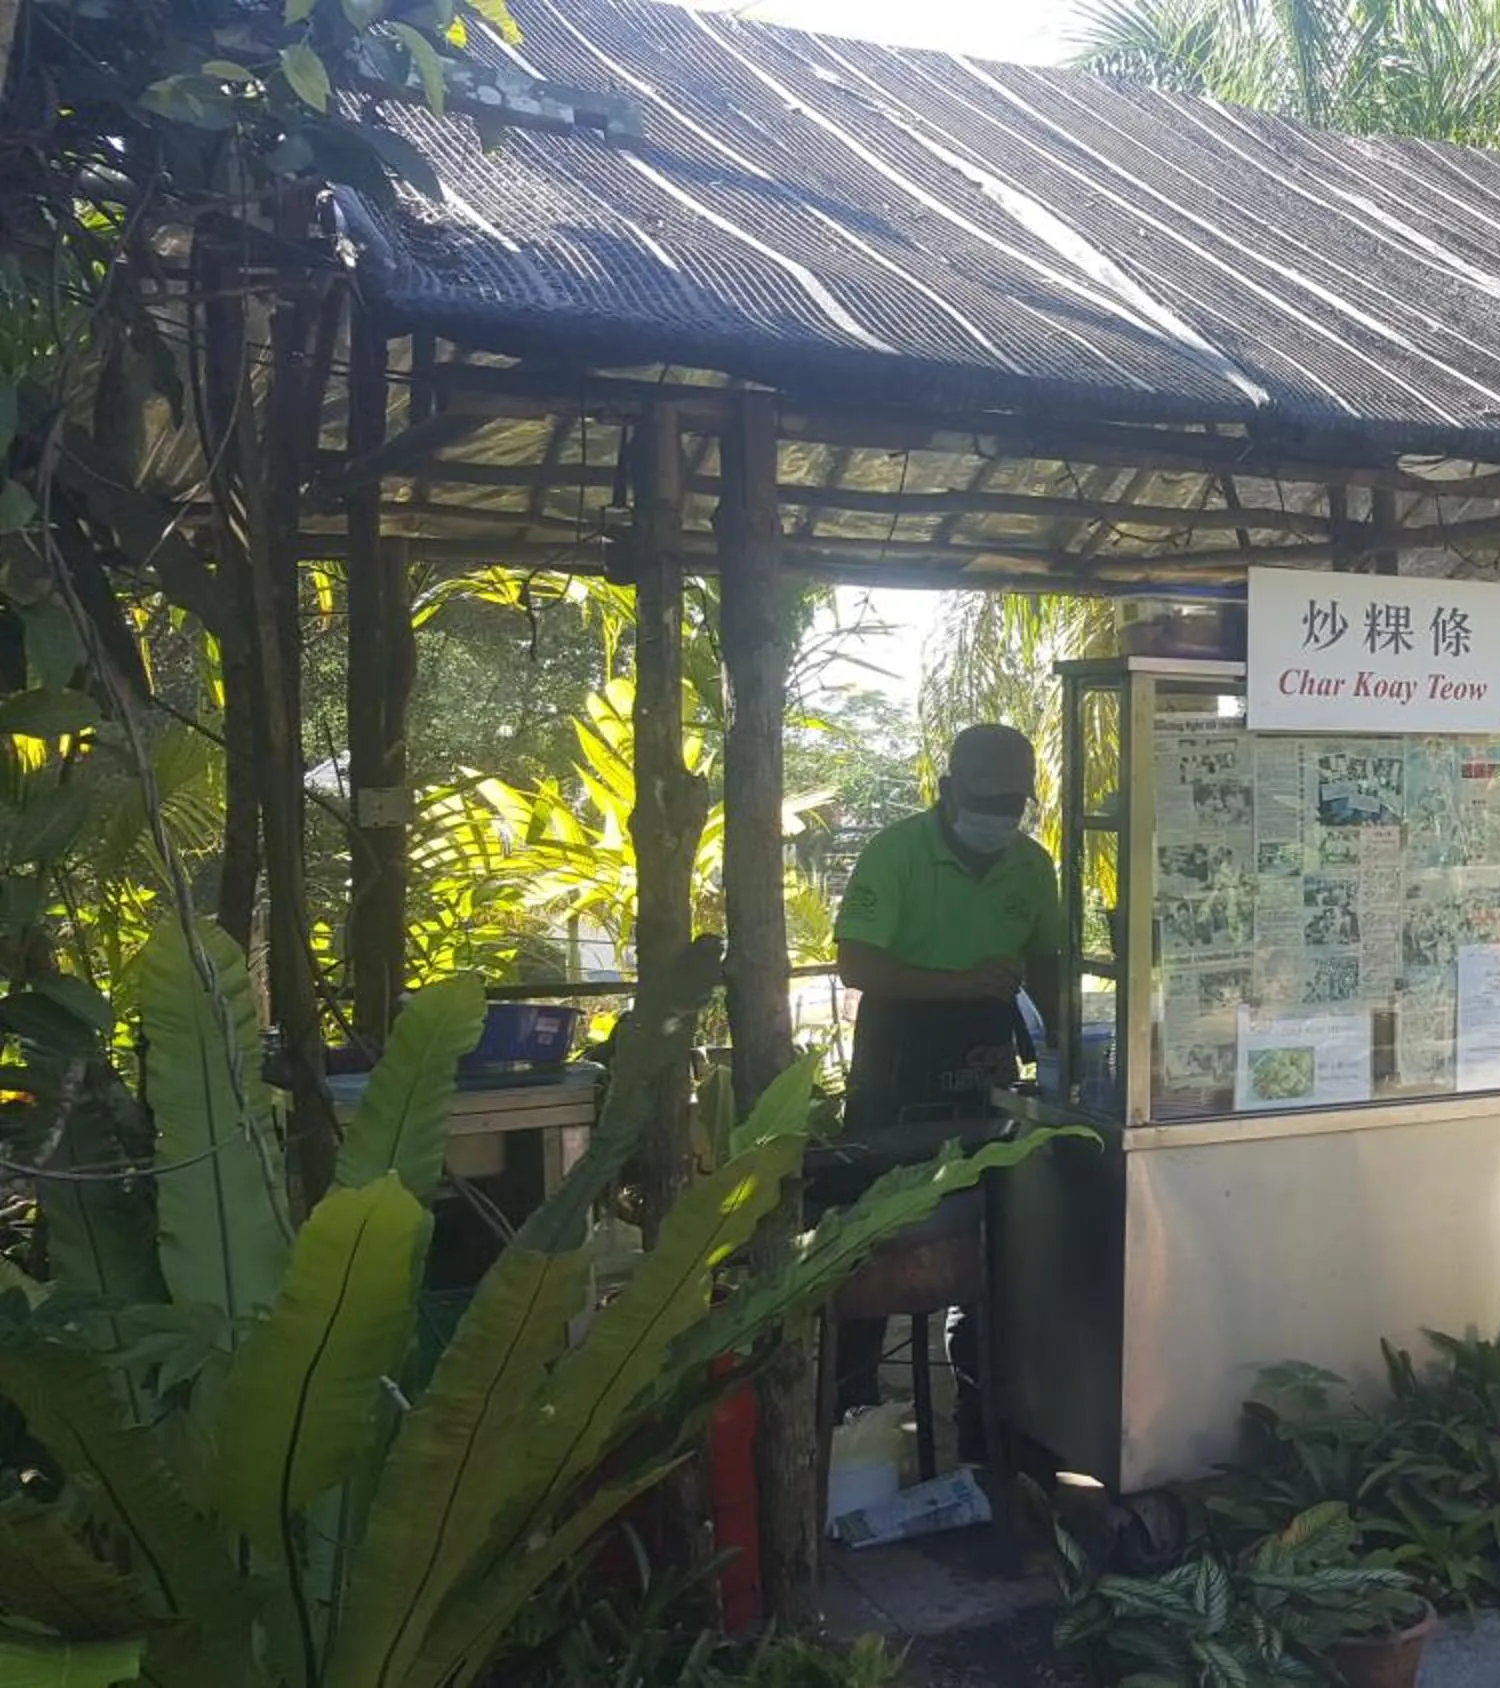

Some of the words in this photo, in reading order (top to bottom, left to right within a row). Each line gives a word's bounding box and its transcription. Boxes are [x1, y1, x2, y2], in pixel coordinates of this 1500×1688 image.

[1302, 599, 1474, 658] 炒粿條
[1279, 668, 1346, 697] Char
[1353, 671, 1417, 704] Koay
[1428, 673, 1487, 701] Teow
